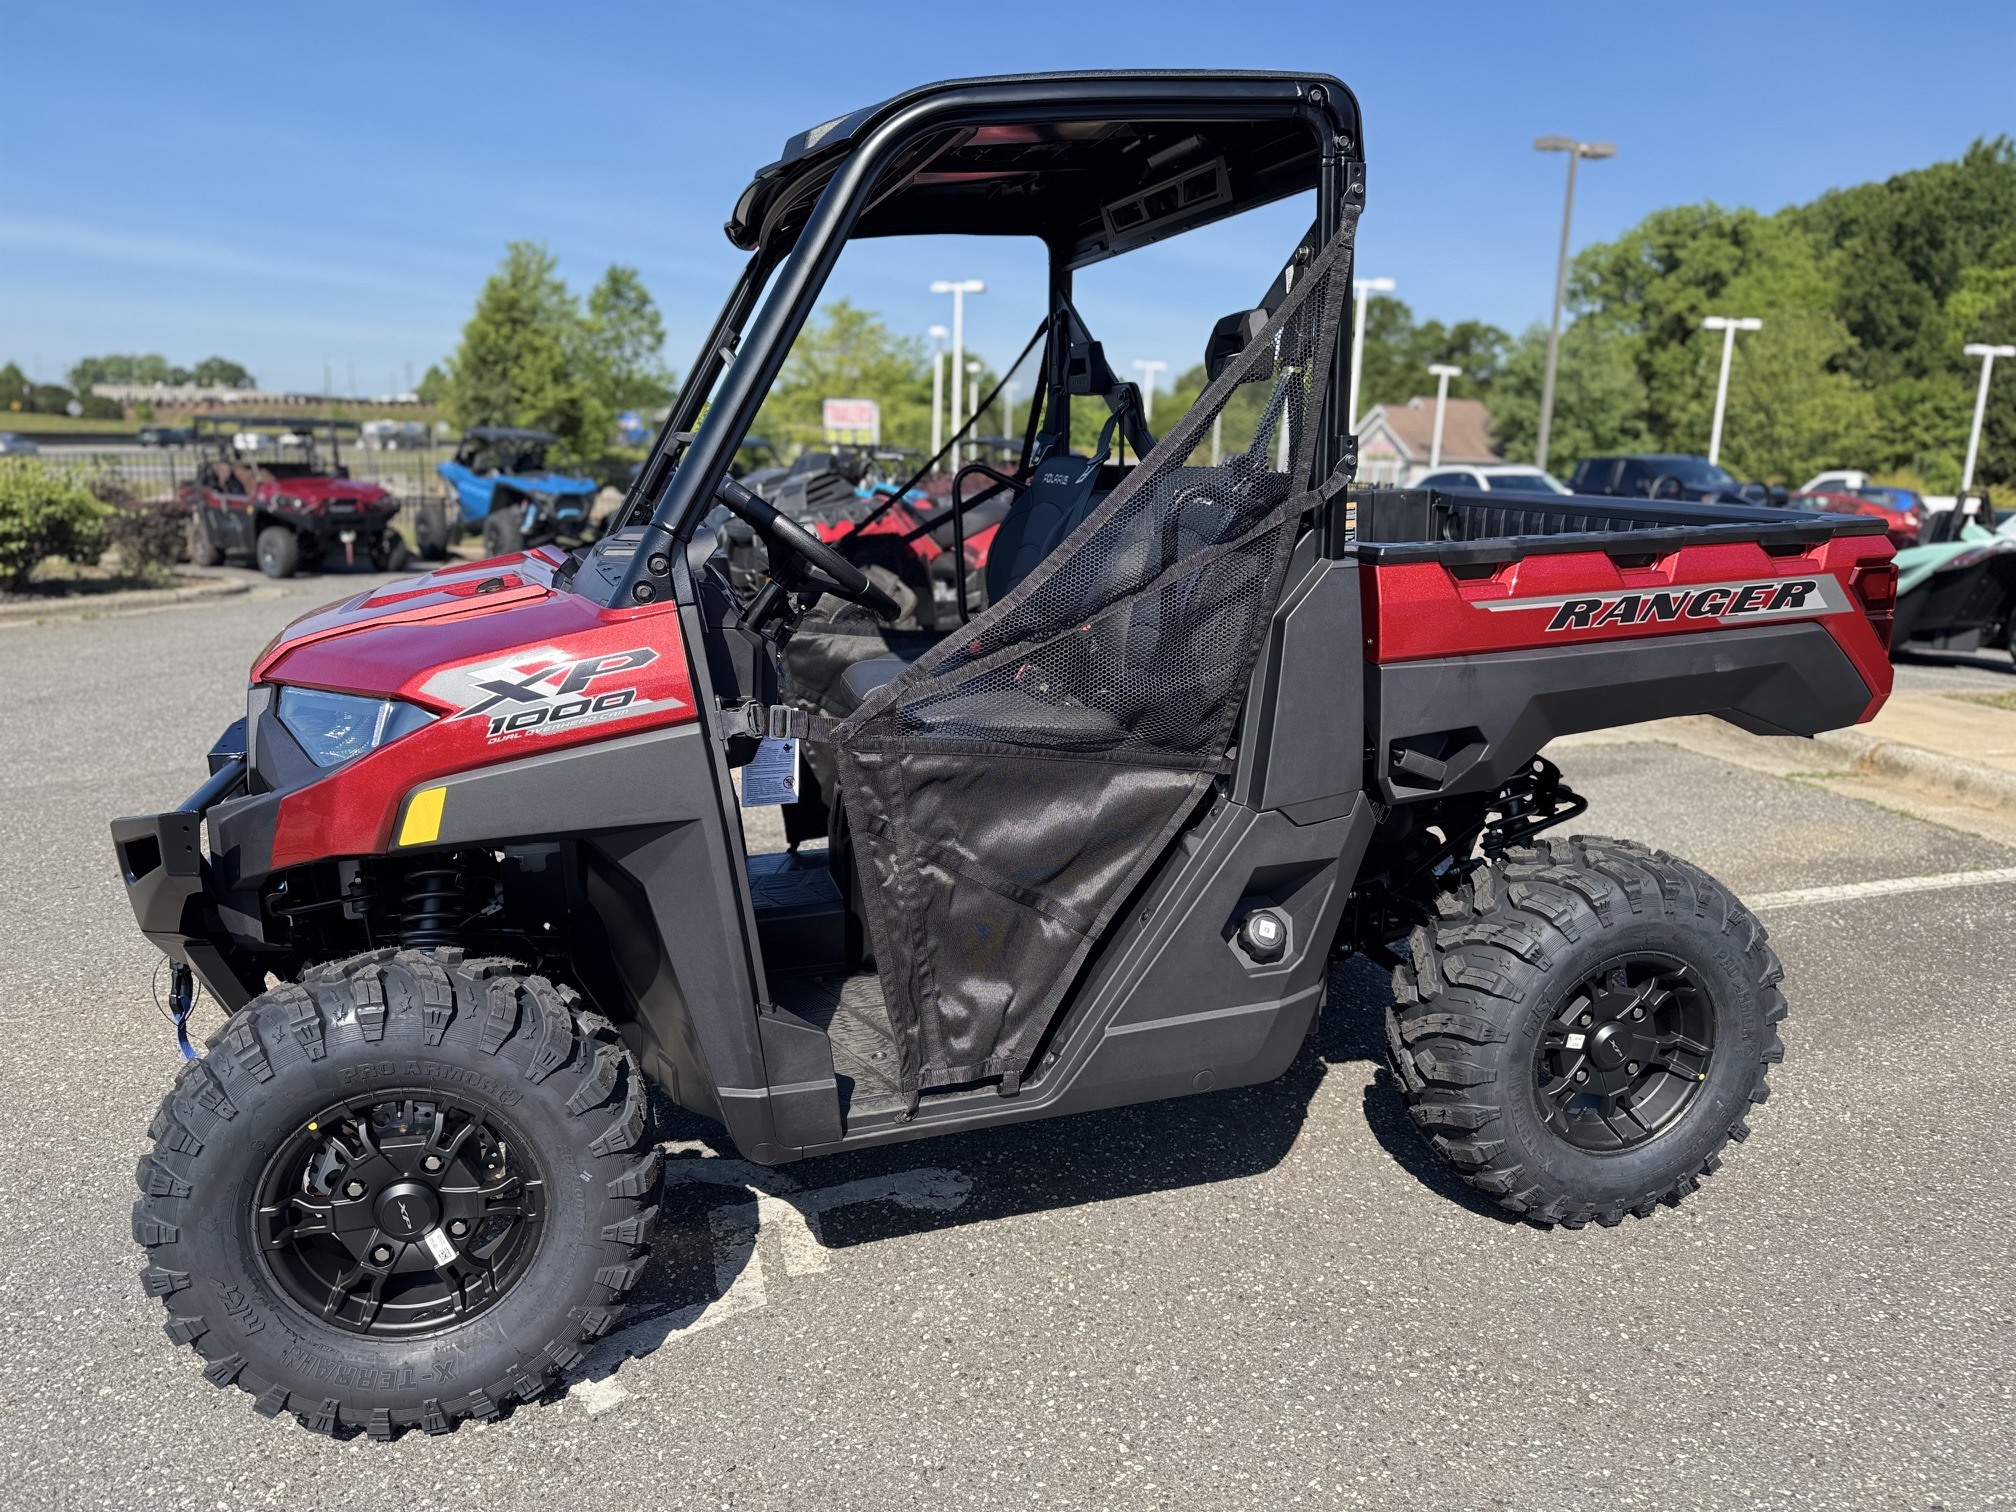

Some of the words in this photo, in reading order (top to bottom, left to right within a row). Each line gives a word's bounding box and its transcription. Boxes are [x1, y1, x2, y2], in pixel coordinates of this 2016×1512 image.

[1043, 473, 1069, 486] POLARIS
[1545, 580, 1818, 631] RANGER
[441, 647, 660, 724] XP
[485, 687, 637, 738] 1000
[488, 734, 522, 745] DUAL
[525, 716, 597, 736] OVERHEAD
[600, 709, 629, 720] CAM
[338, 1061, 396, 1084] PRO
[403, 1061, 499, 1093] ARMOR
[397, 1200, 412, 1230] XP
[281, 1345, 457, 1391] X-TERRAIN
